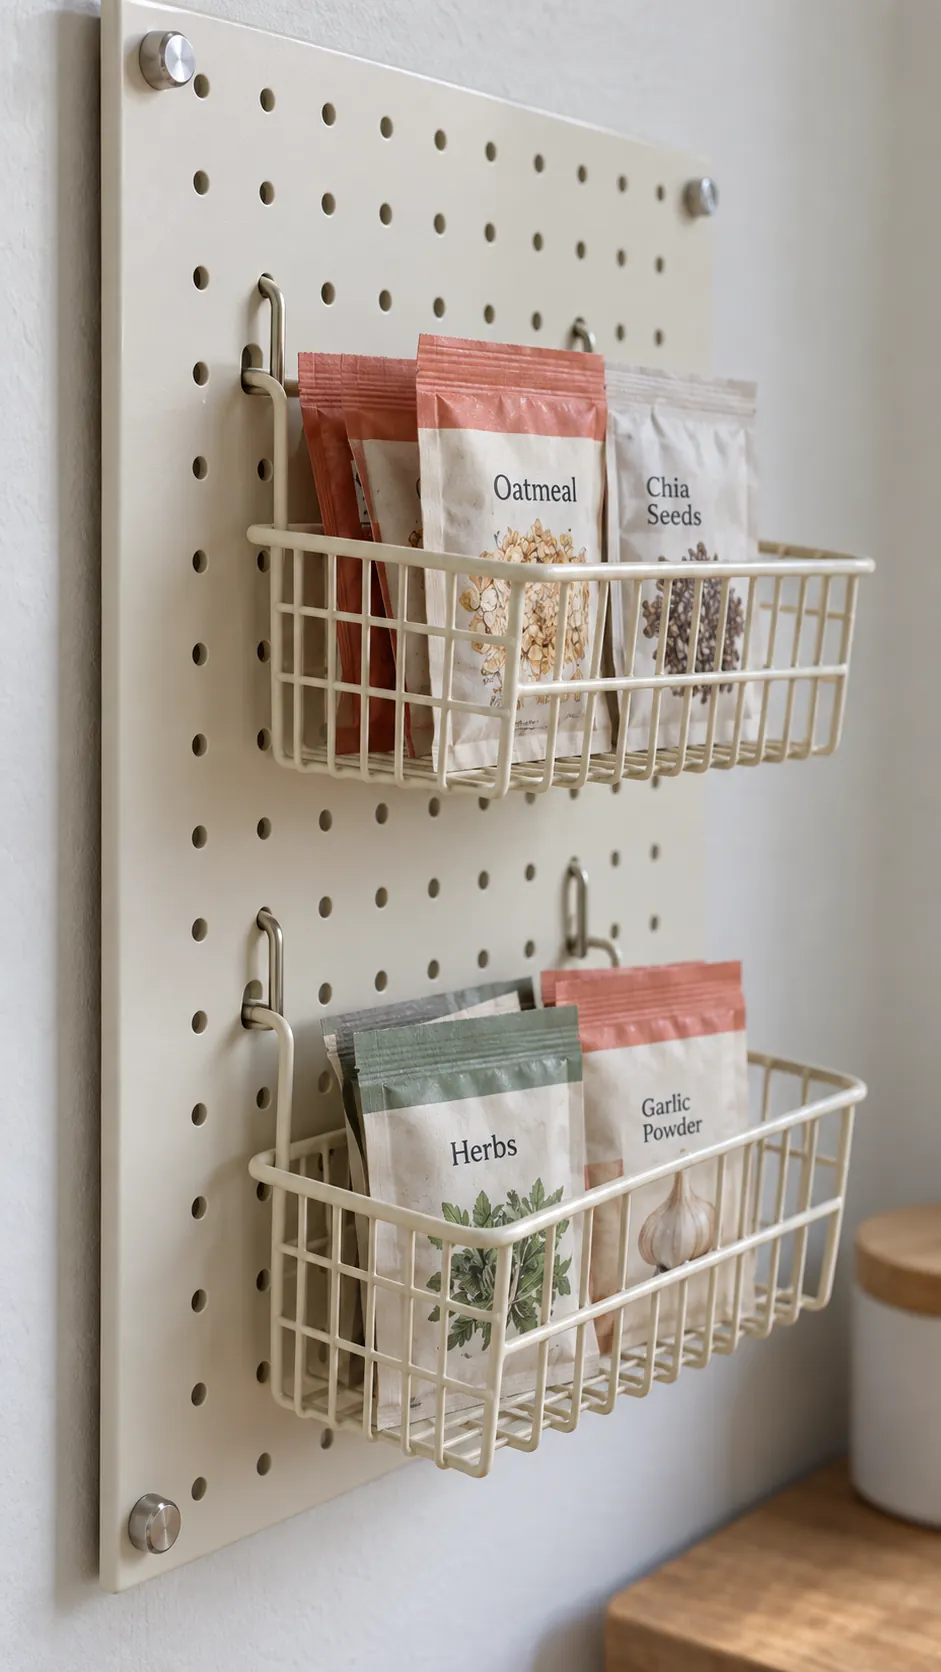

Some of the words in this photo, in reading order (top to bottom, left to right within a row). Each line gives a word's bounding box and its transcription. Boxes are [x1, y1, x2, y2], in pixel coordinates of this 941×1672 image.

[493, 474, 577, 503] Oatmeal
[646, 476, 690, 499] Chia
[647, 503, 702, 526] Seeds
[641, 1093, 691, 1118] Garlic
[643, 1117, 703, 1144] Powder
[450, 1134, 518, 1167] Herbs
